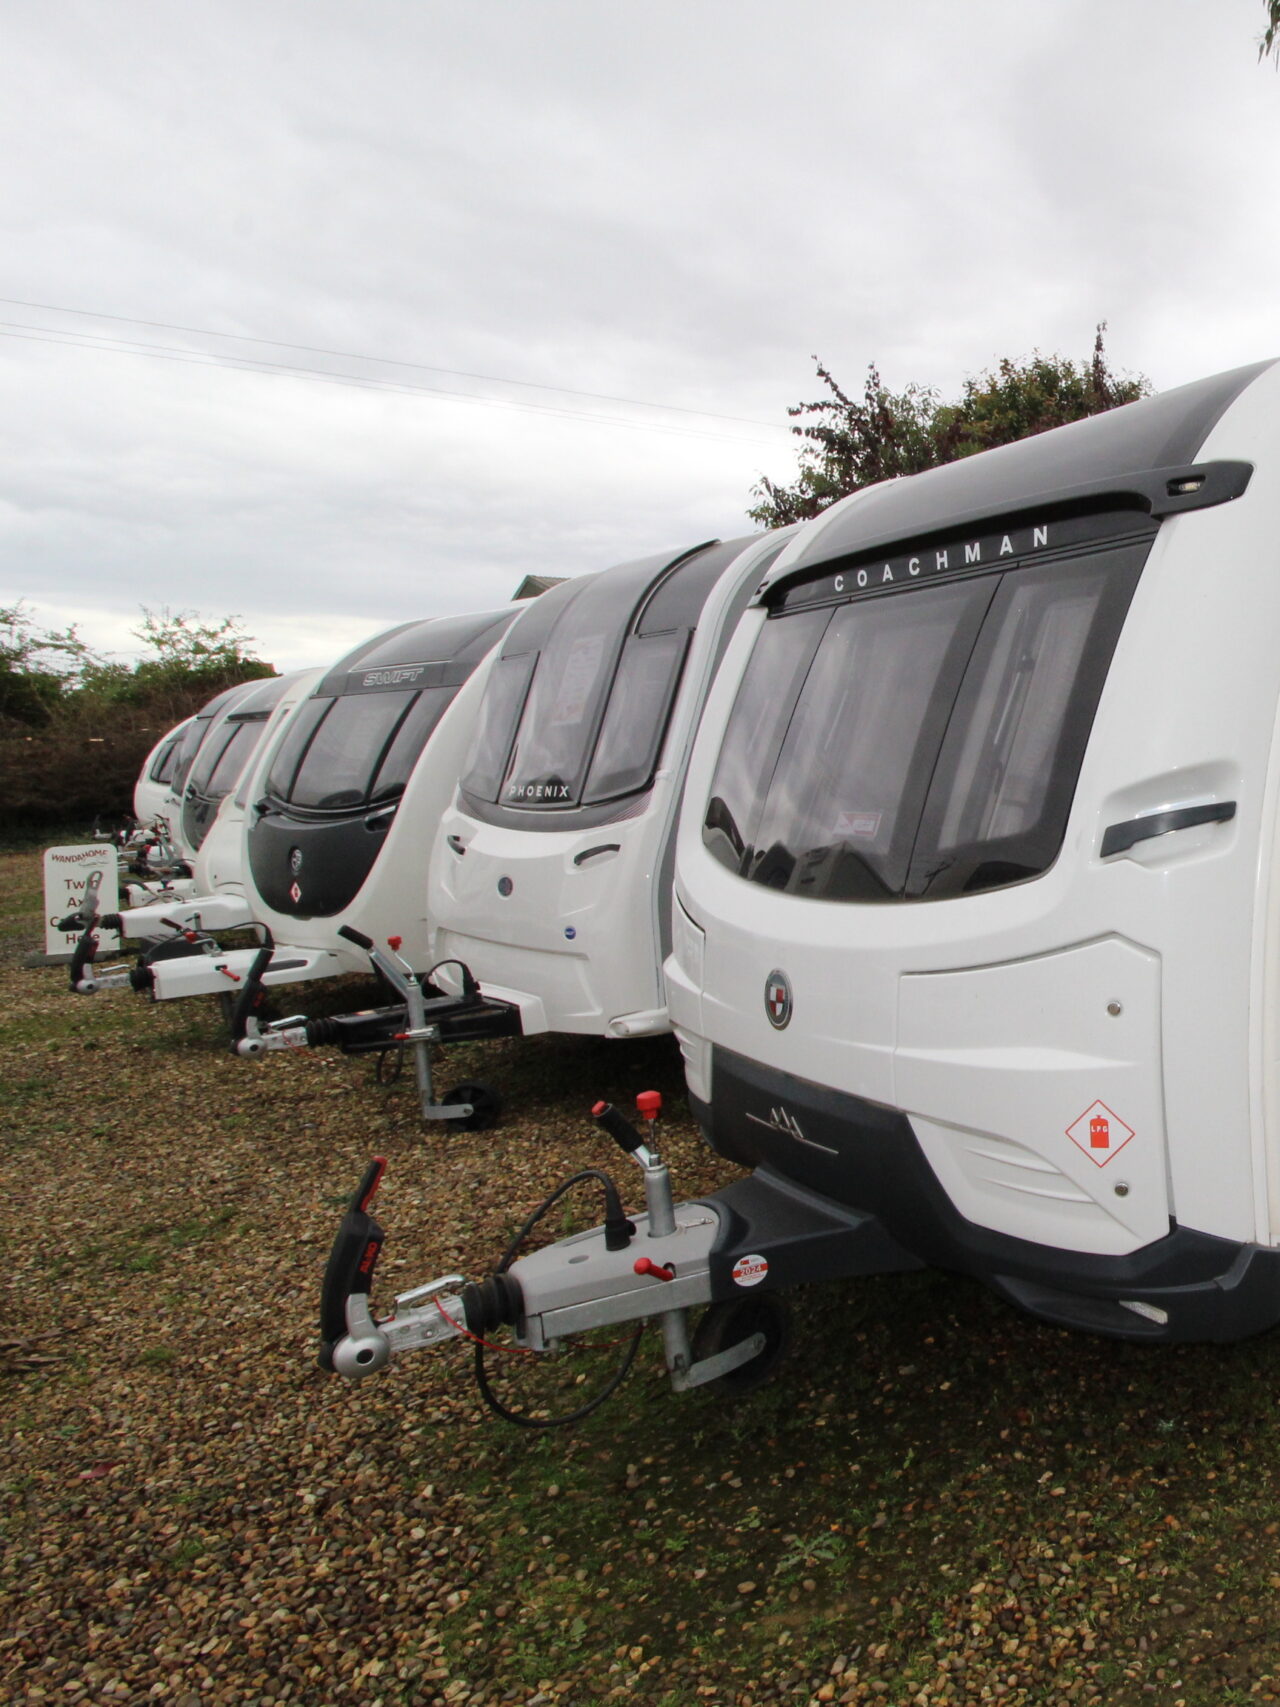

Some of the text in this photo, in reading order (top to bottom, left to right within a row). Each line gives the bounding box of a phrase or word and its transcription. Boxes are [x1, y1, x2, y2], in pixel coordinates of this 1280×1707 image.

[834, 525, 1048, 592] COACHMAN
[362, 667, 424, 686] SWIFT
[508, 785, 569, 798] PHOENIX
[51, 849, 109, 863] WANDAHOME
[64, 879, 99, 890] Twn
[1091, 1125, 1108, 1133] LPG
[740, 1264, 762, 1277] 2024
